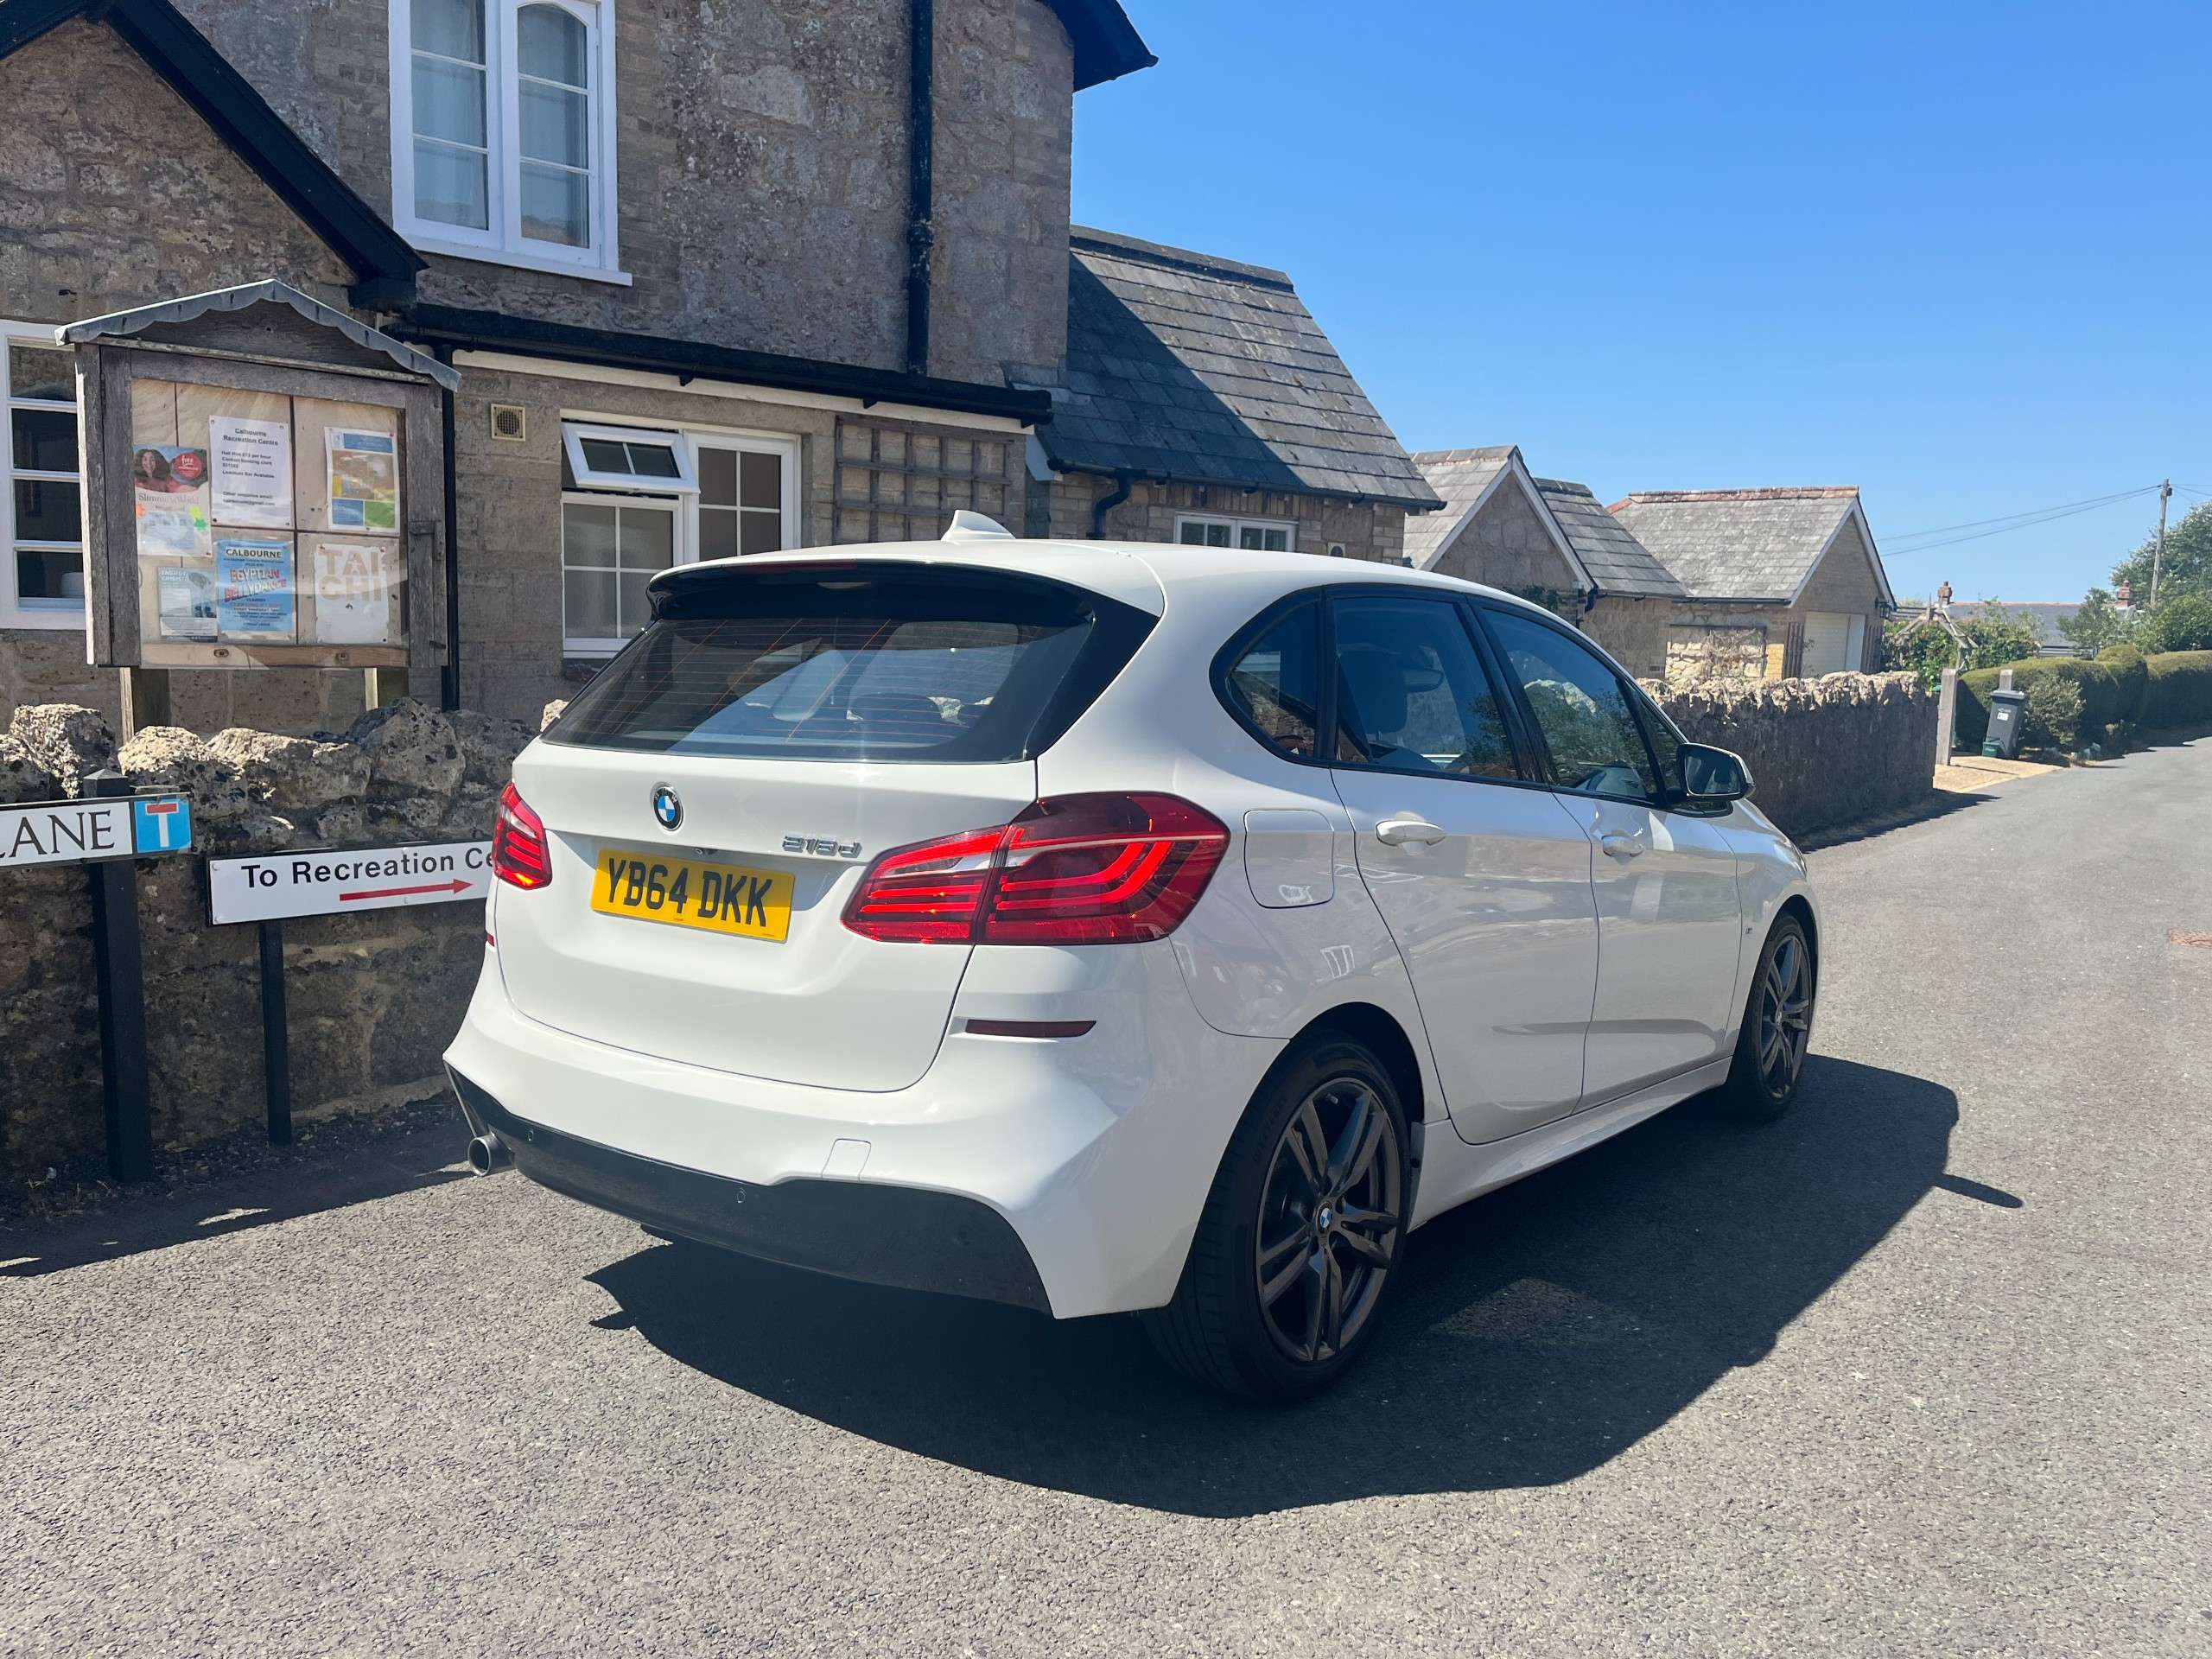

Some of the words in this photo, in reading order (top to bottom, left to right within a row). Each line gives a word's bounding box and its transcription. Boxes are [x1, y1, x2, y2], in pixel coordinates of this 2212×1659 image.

[223, 435, 257, 444] Recreation
[226, 549, 282, 558] CALBOURNE
[317, 550, 378, 576] TAI
[230, 567, 280, 582] EGYPTIAN
[224, 578, 287, 602] BELLYDANCE
[319, 575, 381, 601] CHI
[0, 810, 115, 859] ANE
[241, 864, 277, 888] To
[292, 853, 454, 884] Recreation
[608, 857, 689, 914] YB64
[697, 870, 772, 927] DKK
